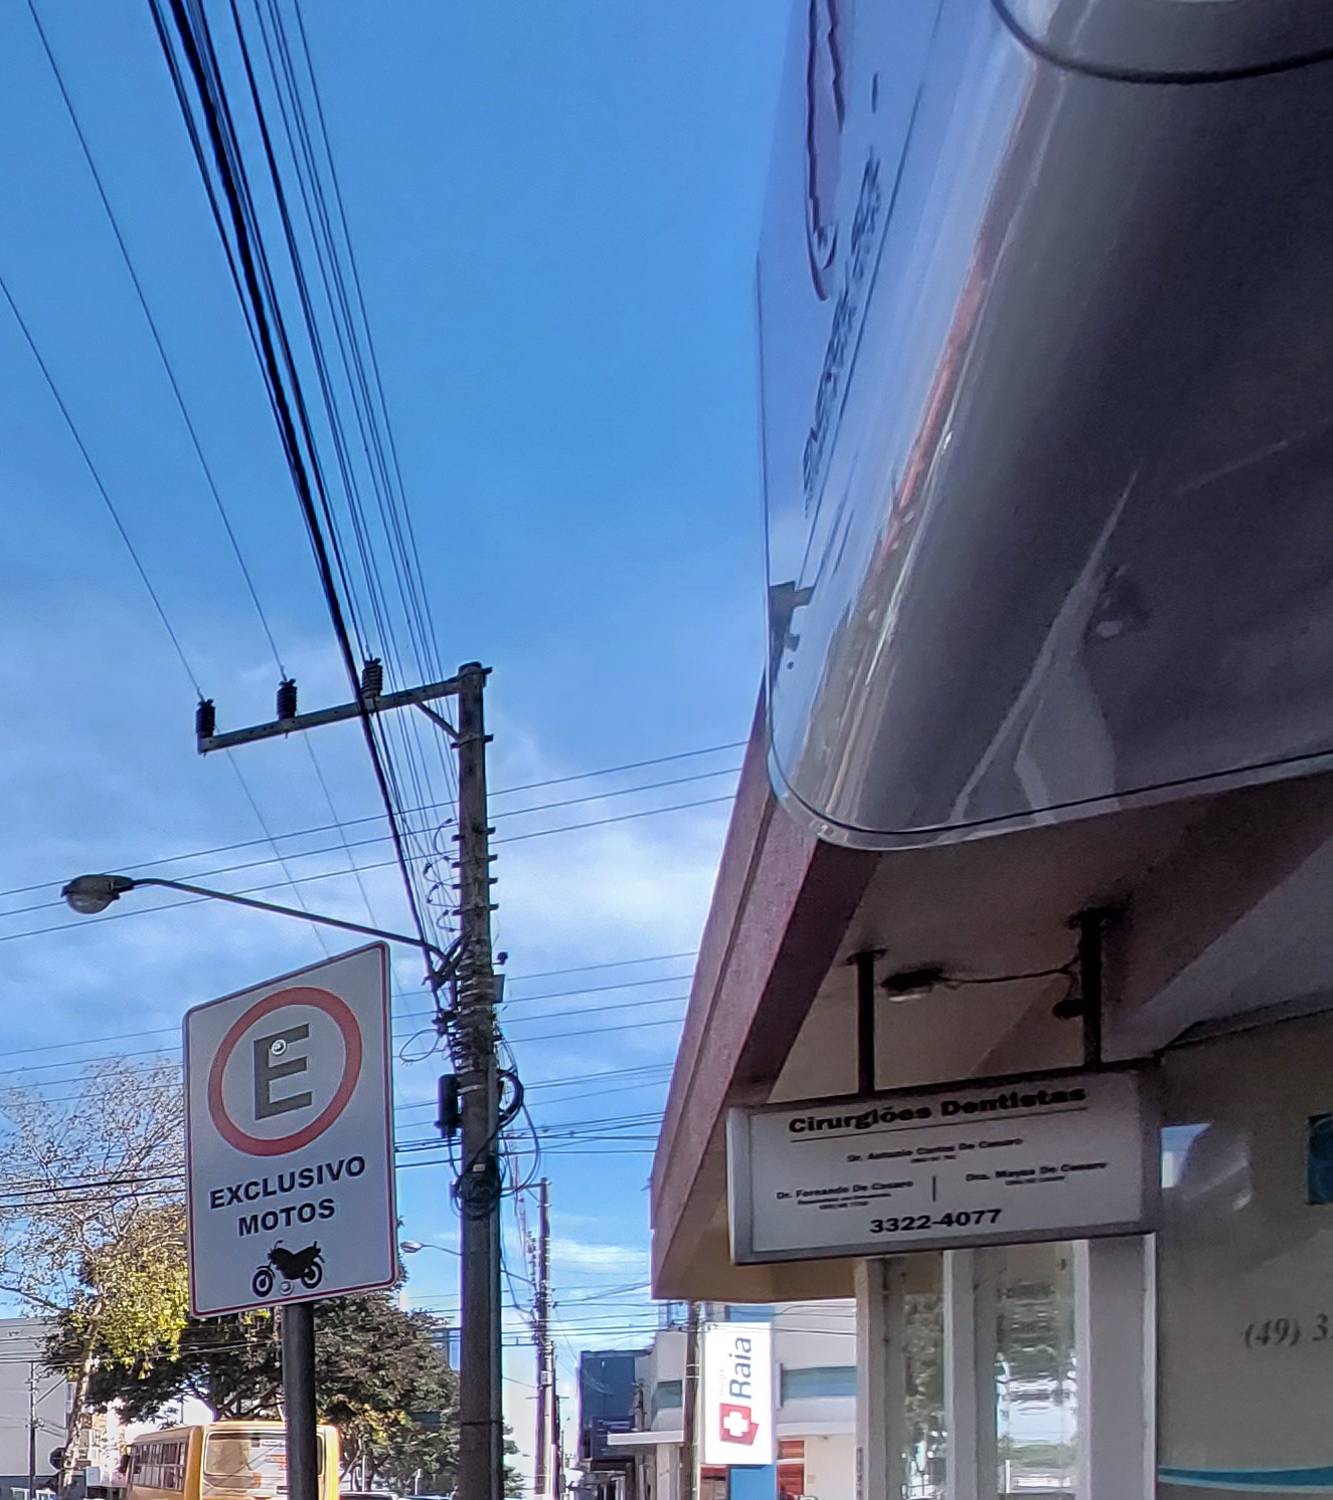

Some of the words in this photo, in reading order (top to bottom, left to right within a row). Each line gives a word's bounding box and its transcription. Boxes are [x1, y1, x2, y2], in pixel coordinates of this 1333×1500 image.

[253, 1022, 313, 1121] E
[788, 1104, 933, 1134] Cirurgiões
[941, 1086, 1087, 1117] Dentistas
[209, 1155, 366, 1210] EXCLUSIVO
[238, 1198, 336, 1237] MOTOS
[869, 1208, 1003, 1234] 3322-4077
[1245, 1317, 1300, 1349] (49)
[729, 1337, 752, 1399] Raia
